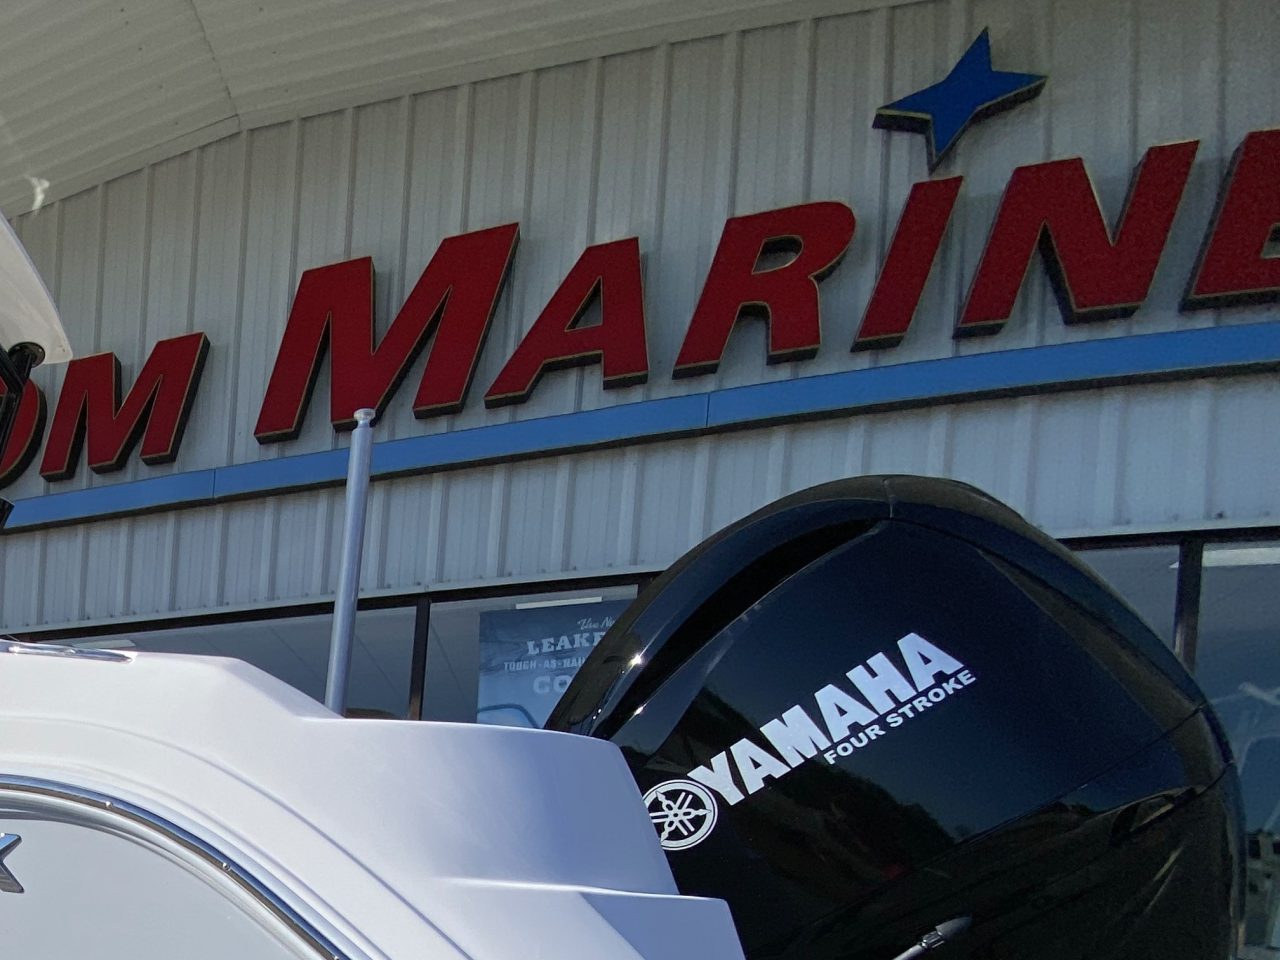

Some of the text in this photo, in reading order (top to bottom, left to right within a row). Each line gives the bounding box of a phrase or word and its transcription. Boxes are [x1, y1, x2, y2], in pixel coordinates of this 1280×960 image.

[687, 632, 966, 807] YAMAHA
[824, 669, 977, 766] FOUR STROKE
